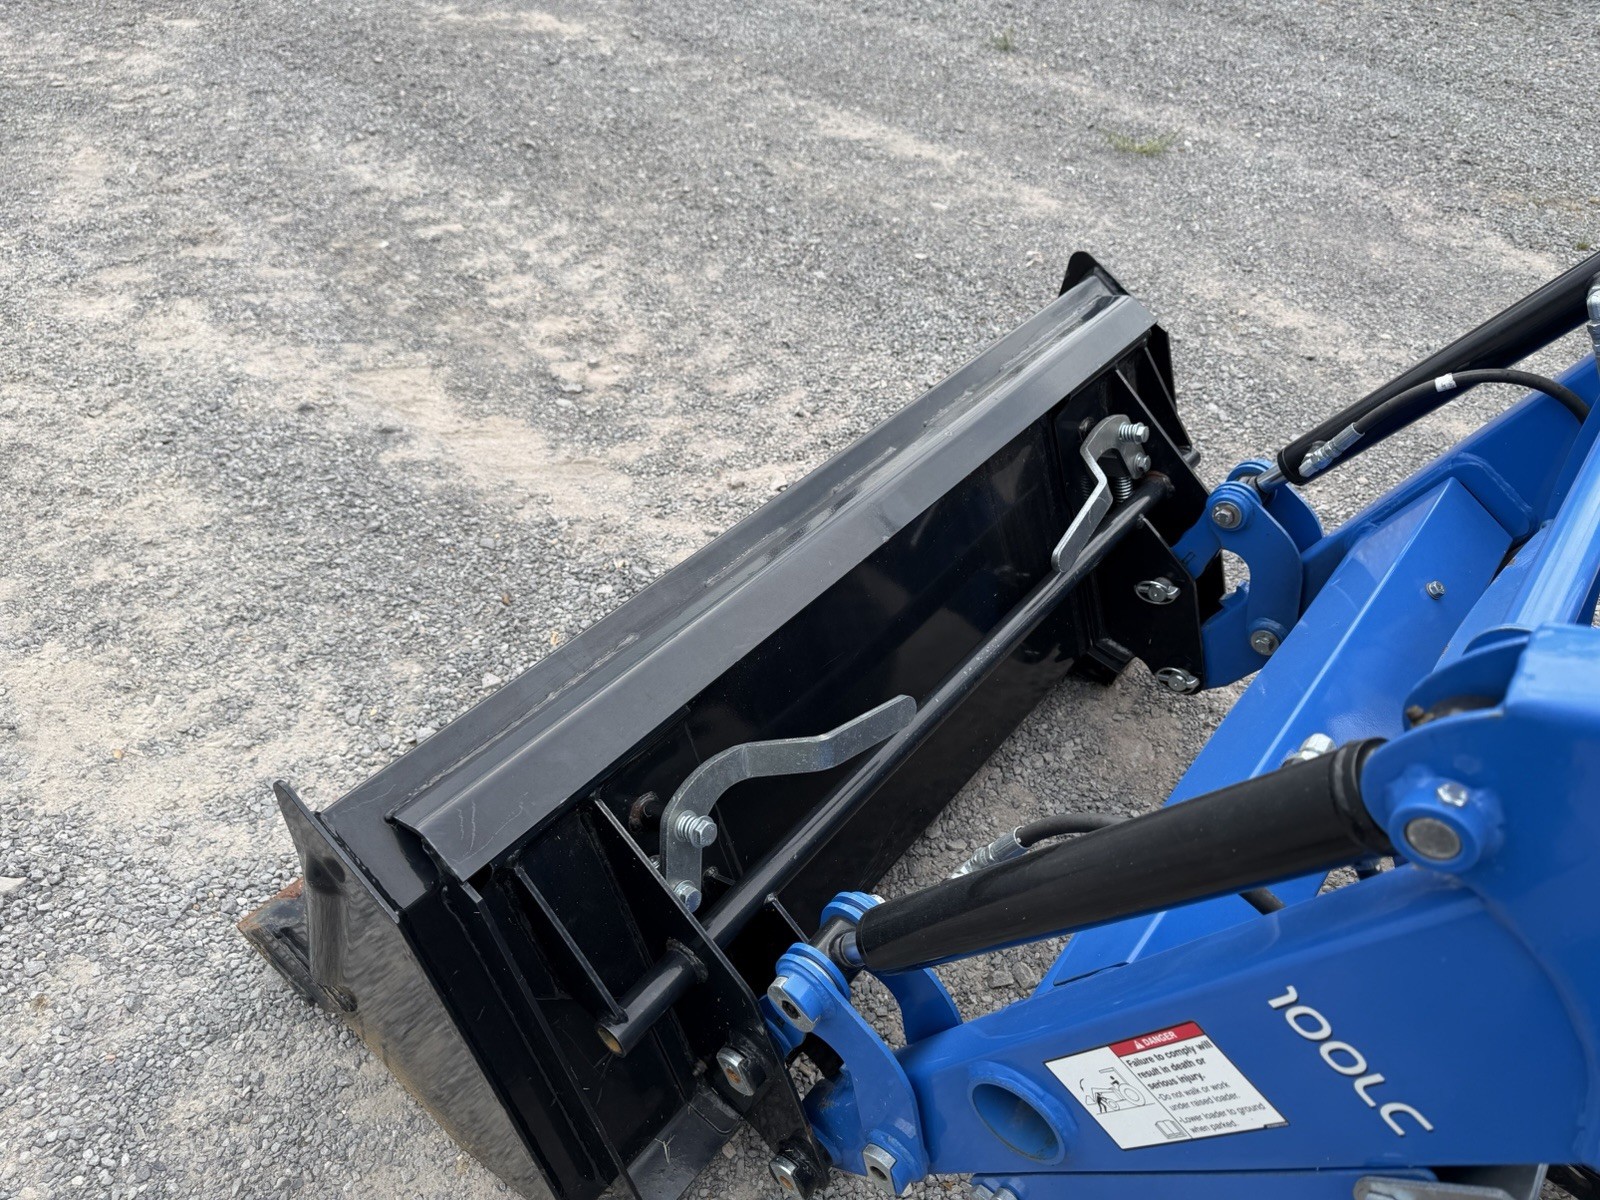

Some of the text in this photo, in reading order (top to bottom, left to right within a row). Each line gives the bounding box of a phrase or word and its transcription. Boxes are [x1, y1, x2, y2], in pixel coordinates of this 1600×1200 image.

[1143, 1030, 1178, 1046] DANGER
[1125, 1039, 1214, 1068] Failure to comply will
[1268, 985, 1434, 1136] 100LC
[1137, 1057, 1206, 1079] result in death or
[1147, 1071, 1206, 1090] serious injury.
[1171, 1089, 1185, 1100] not
[1184, 1087, 1201, 1097] walk
[1201, 1084, 1210, 1093] or
[1210, 1081, 1230, 1091] work
[1169, 1092, 1241, 1111] under raised loader.
[1202, 1110, 1227, 1120] loader
[1226, 1108, 1237, 1116] to
[1236, 1102, 1266, 1116] ground
[1189, 1119, 1240, 1134] when parked.
